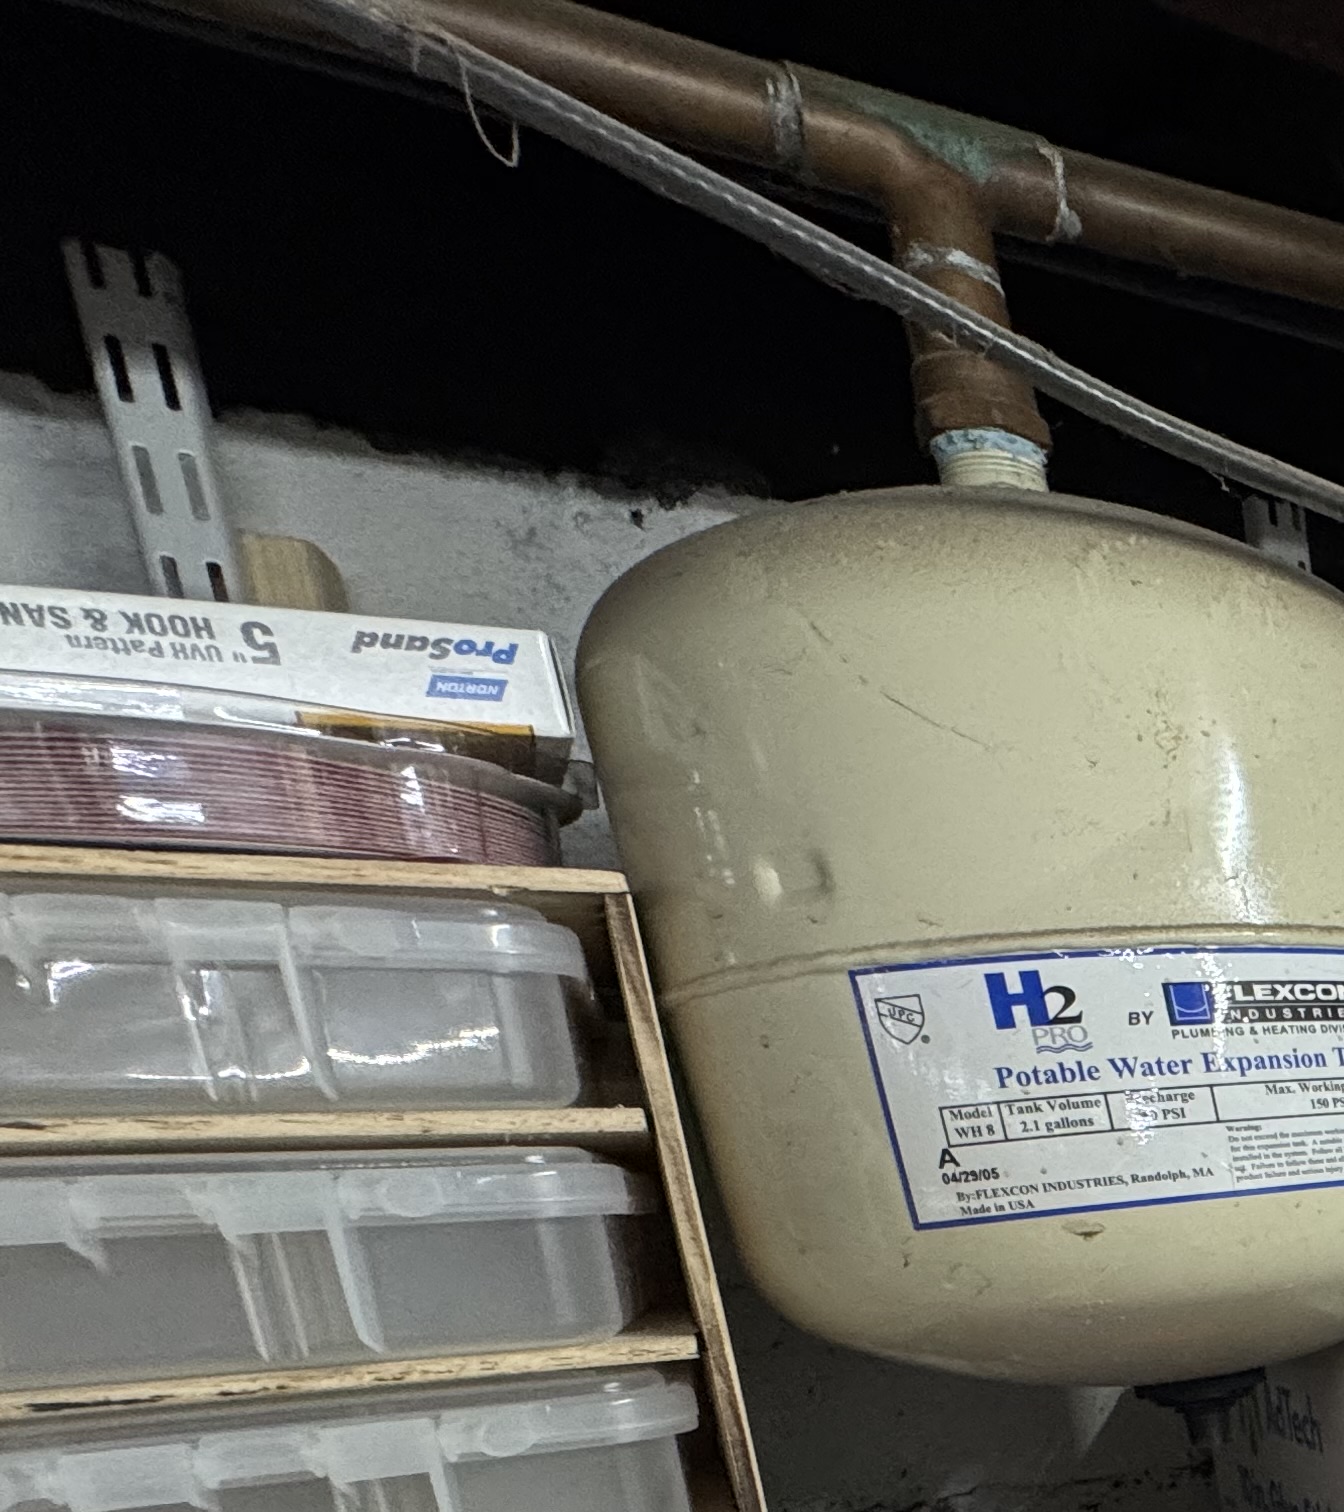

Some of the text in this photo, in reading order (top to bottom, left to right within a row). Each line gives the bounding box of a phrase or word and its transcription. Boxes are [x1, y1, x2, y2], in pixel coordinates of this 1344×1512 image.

[80, 607, 108, 632] &
[119, 610, 216, 640] HOOK
[64, 634, 164, 659] Pattern
[170, 642, 223, 662] UVH
[351, 630, 519, 664] ProSand
[436, 680, 499, 697] NORTON
[984, 970, 1083, 1030] H2
[888, 1008, 916, 1022] UPC
[1128, 1011, 1153, 1025] BY
[1032, 1026, 1088, 1045] PRO
[1249, 1026, 1257, 1036] &
[1262, 1024, 1316, 1035] HEATING
[993, 1060, 1101, 1089] Potable
[1106, 1055, 1193, 1079] Water
[1200, 1049, 1327, 1077] Expansion
[1265, 1084, 1296, 1096] Max.
[949, 1106, 992, 1121] Model
[1006, 1098, 1102, 1116] Tank Volume
[1310, 1099, 1329, 1110] 150
[1162, 1108, 1187, 1120] PSI
[955, 1124, 995, 1139] WH 8
[1020, 1116, 1094, 1133] 2.1 gallons
[939, 1148, 960, 1169] A
[942, 1167, 1000, 1185] 04/29/05
[1042, 1175, 1129, 1193] INDUSTRIES,
[1131, 1169, 1190, 1185] Randolph,
[1192, 1167, 1215, 1179] MA
[960, 1200, 1035, 1217] Made in USA
